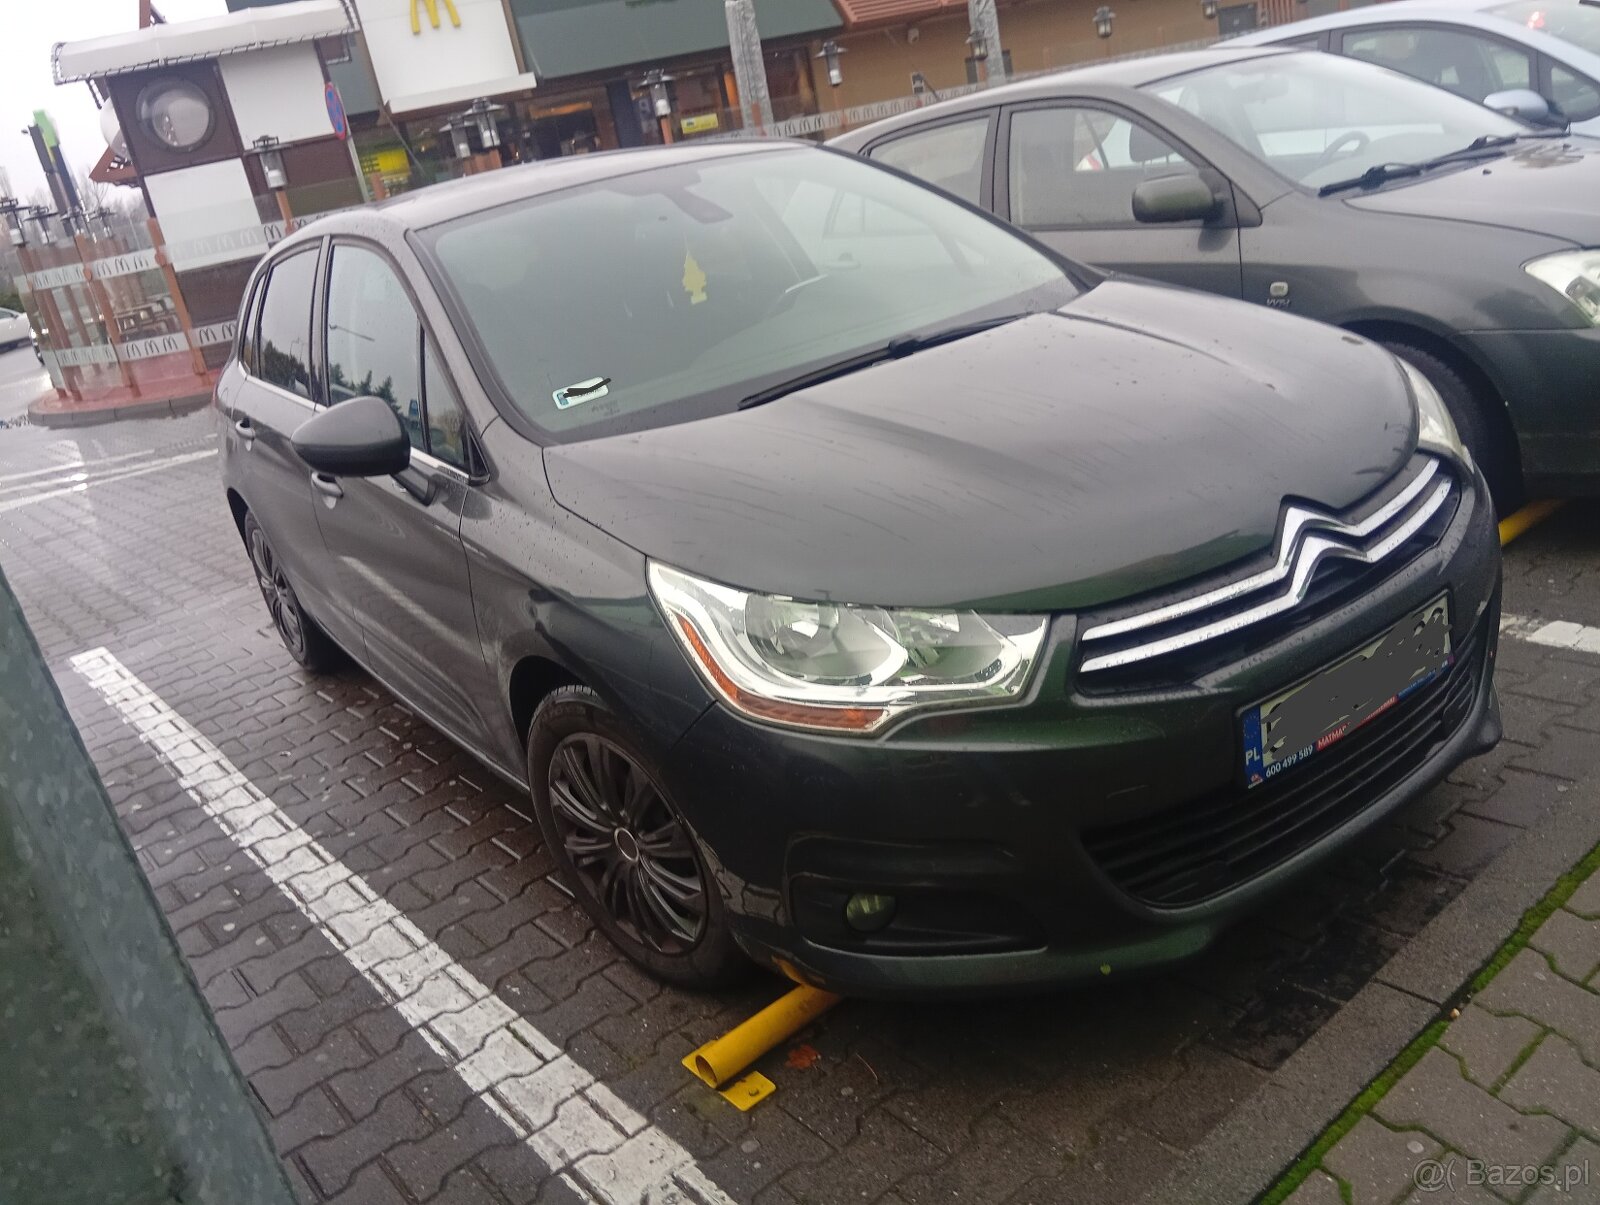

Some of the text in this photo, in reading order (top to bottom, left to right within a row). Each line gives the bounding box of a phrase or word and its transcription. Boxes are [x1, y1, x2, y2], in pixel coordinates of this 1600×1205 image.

[1245, 747, 1260, 766] PL
[1265, 763, 1281, 778] 600
[1282, 754, 1298, 769] 499
[1298, 744, 1314, 760] 589
